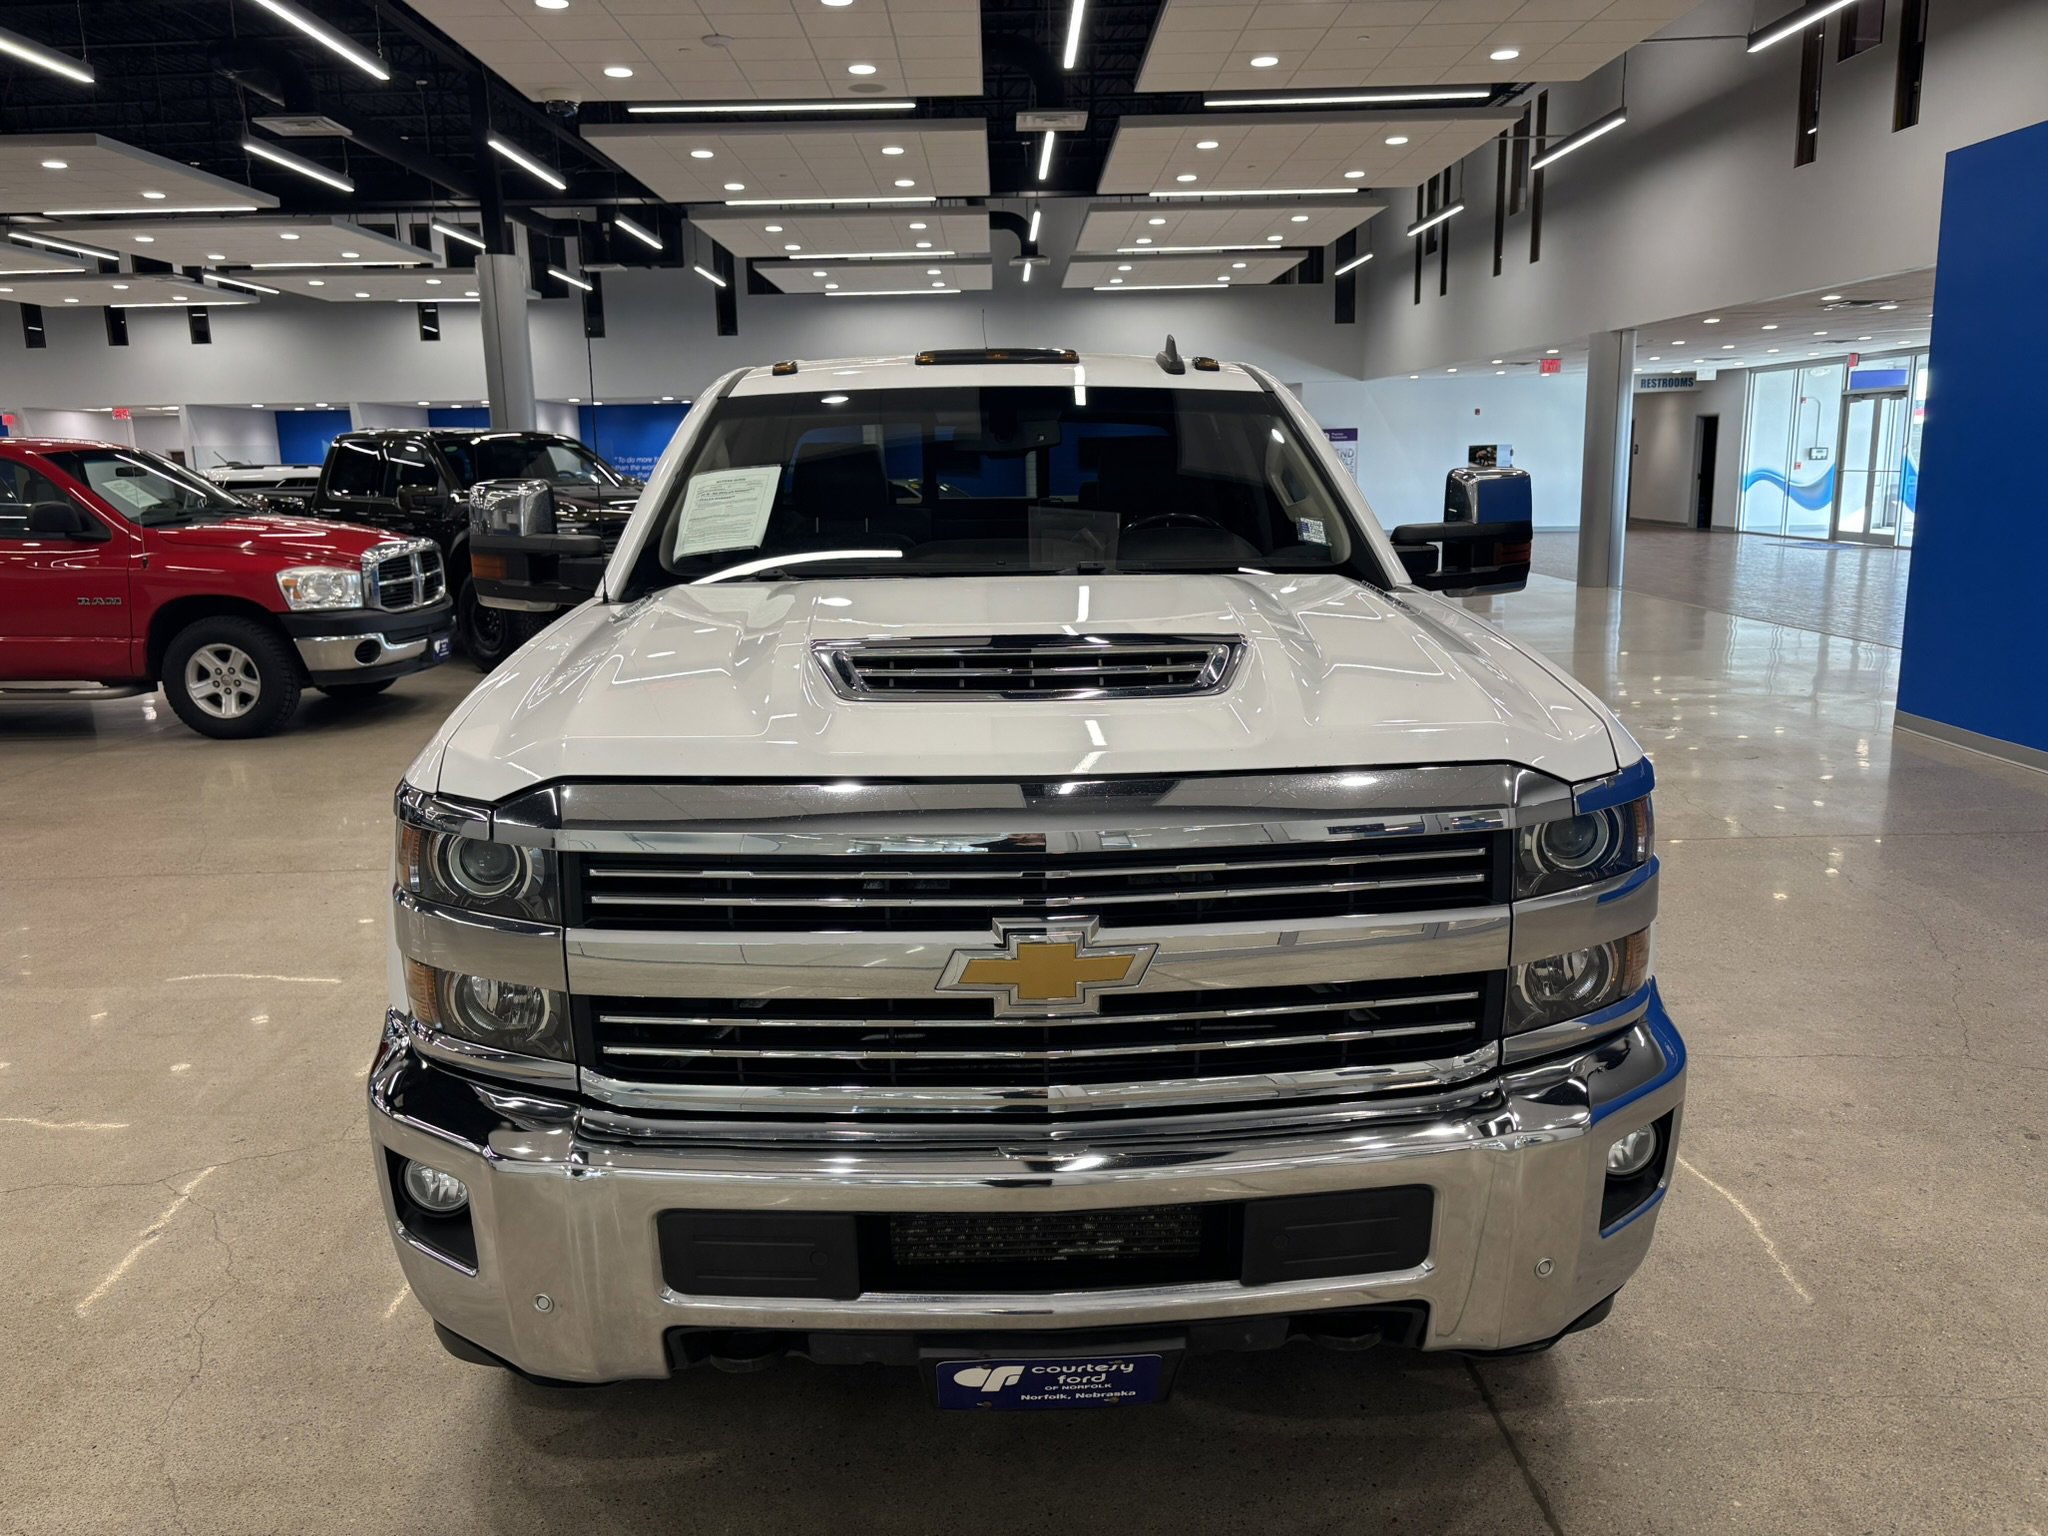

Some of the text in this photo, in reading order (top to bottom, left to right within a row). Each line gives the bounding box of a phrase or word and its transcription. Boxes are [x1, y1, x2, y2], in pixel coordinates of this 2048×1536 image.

[1640, 377, 1694, 388] RESTROOMS
[77, 597, 122, 606] RAM
[1031, 1362, 1135, 1375] courtesy
[1057, 1373, 1107, 1385] ford
[1061, 1383, 1112, 1391] NORFOLK
[1020, 1390, 1137, 1401] Norfolk, Nebraska
